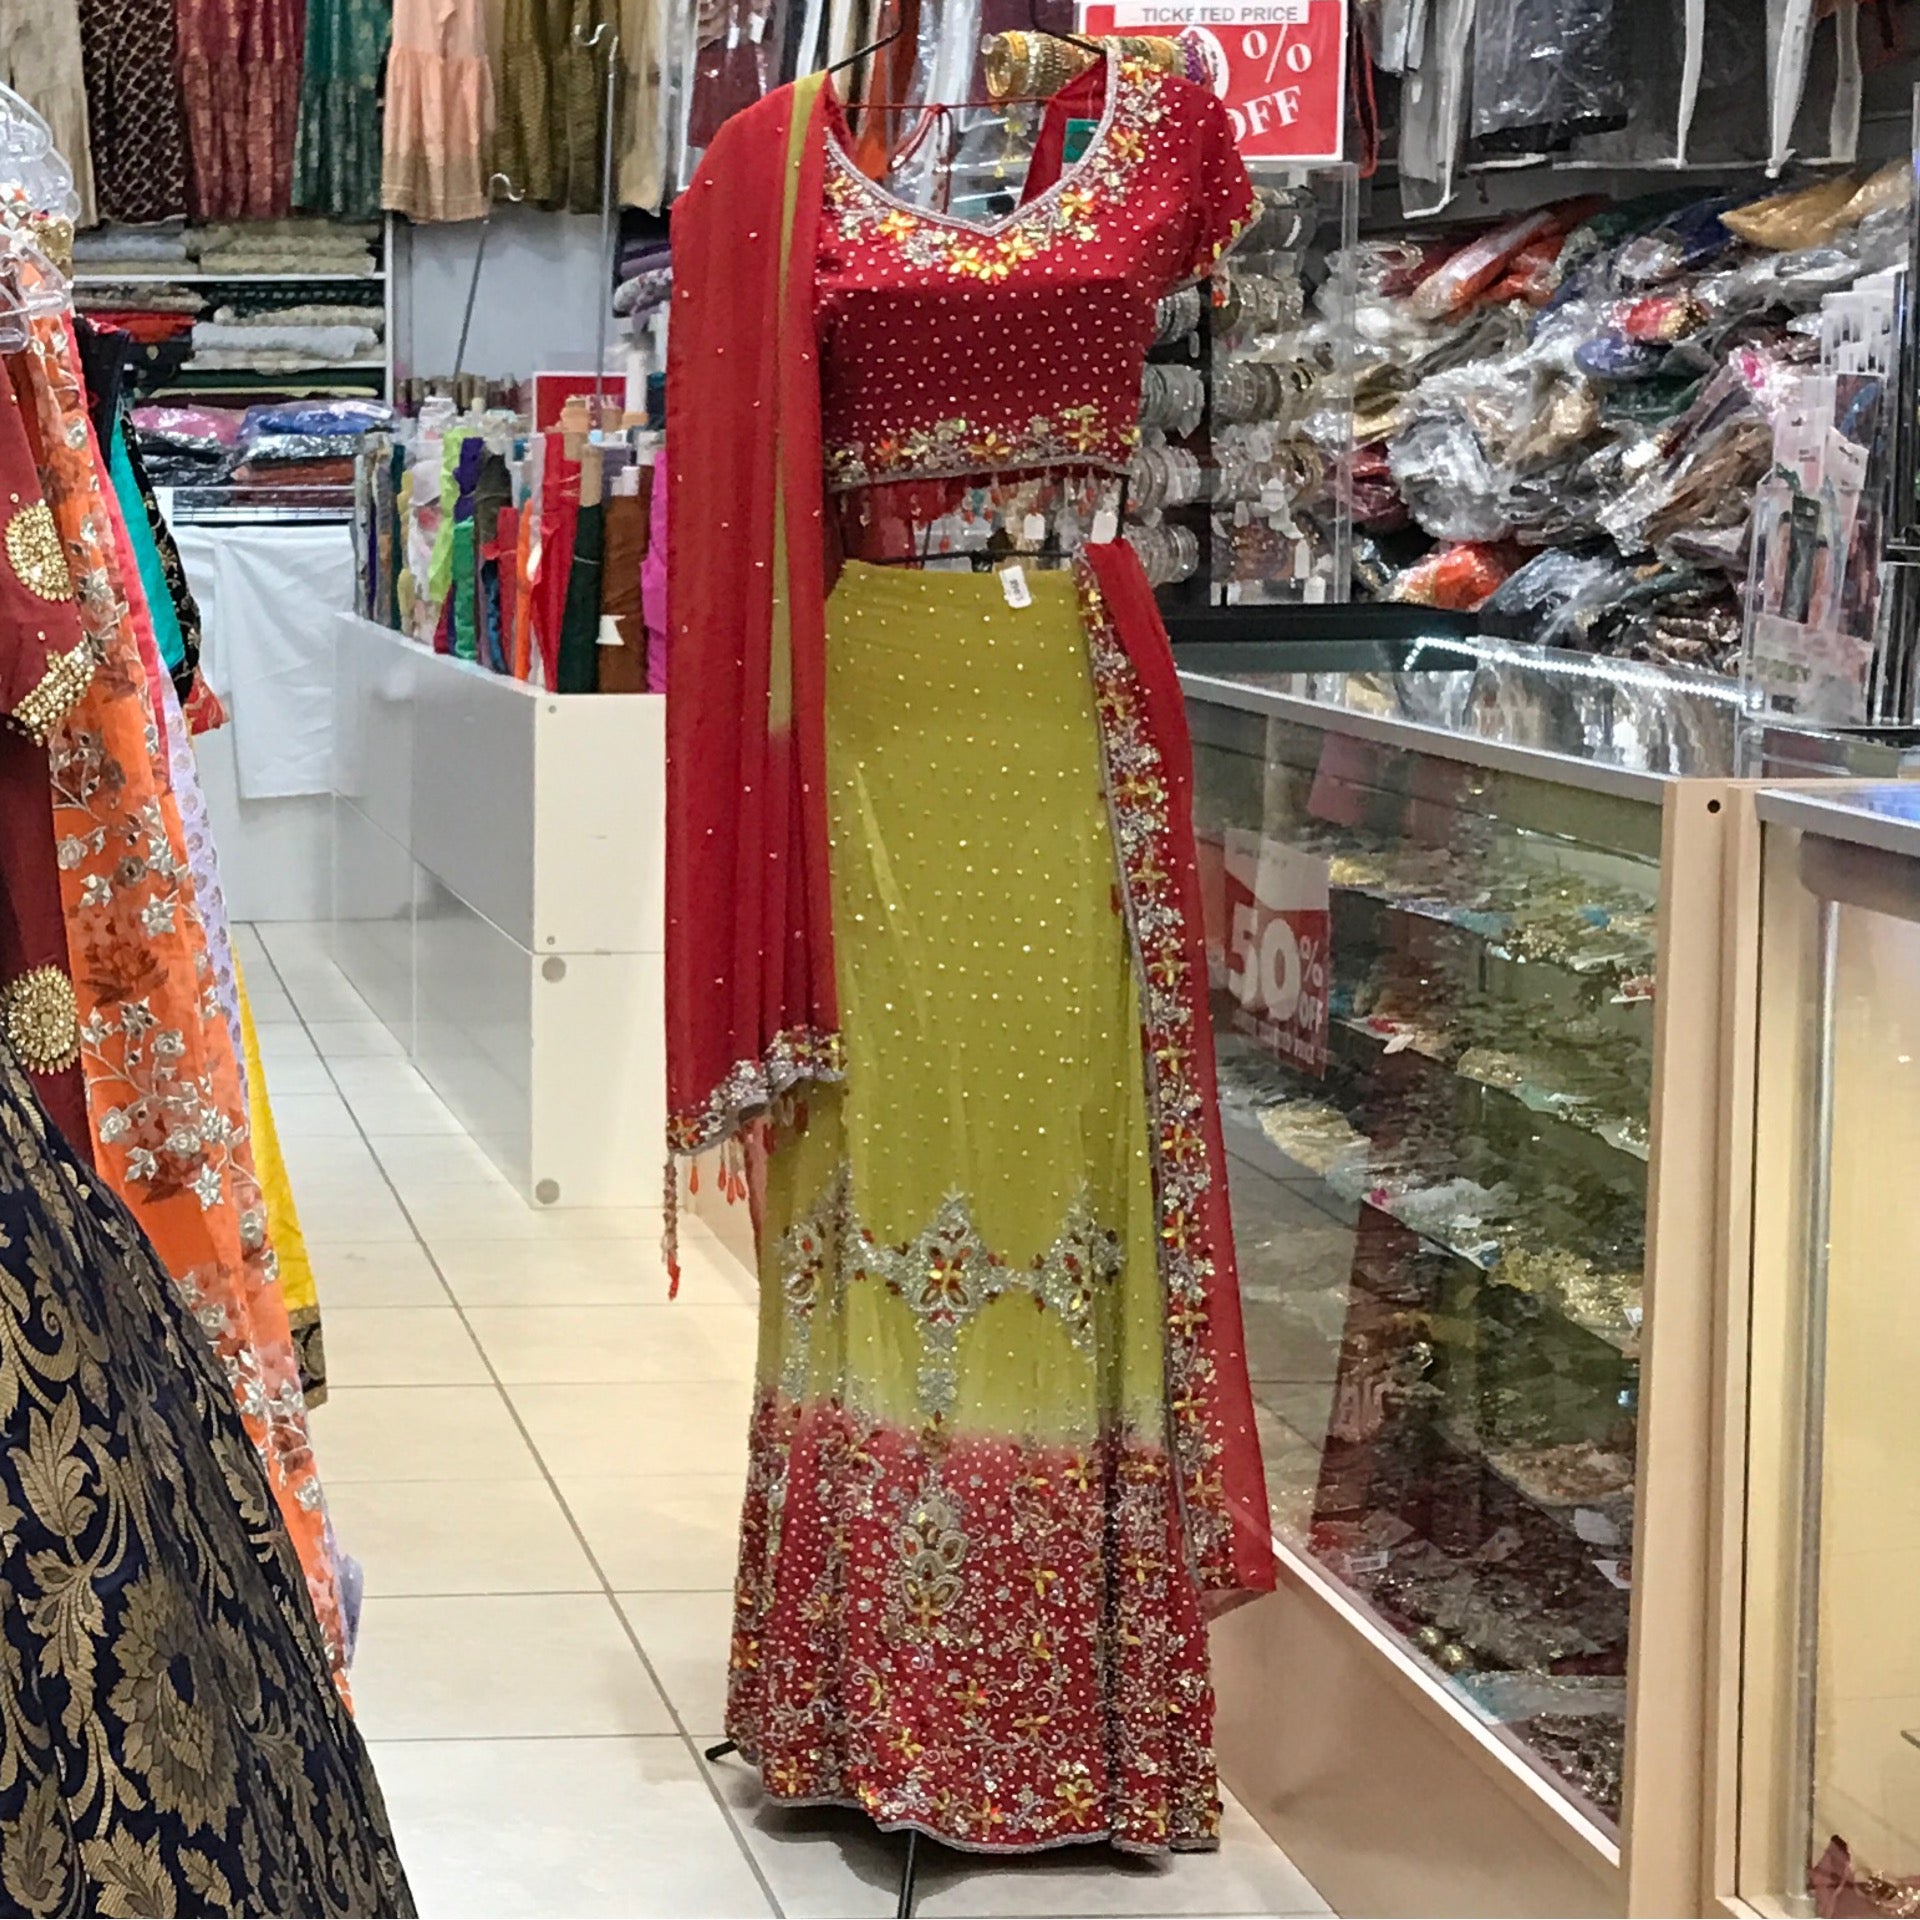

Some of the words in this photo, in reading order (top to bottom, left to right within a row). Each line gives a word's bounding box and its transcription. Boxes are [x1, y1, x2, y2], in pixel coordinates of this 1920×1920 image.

[1142, 7, 1235, 22] TICKETED
[1241, 6, 1298, 21] PRICE
[1228, 901, 1325, 1021] 50%
[1299, 991, 1323, 1034] OFF
